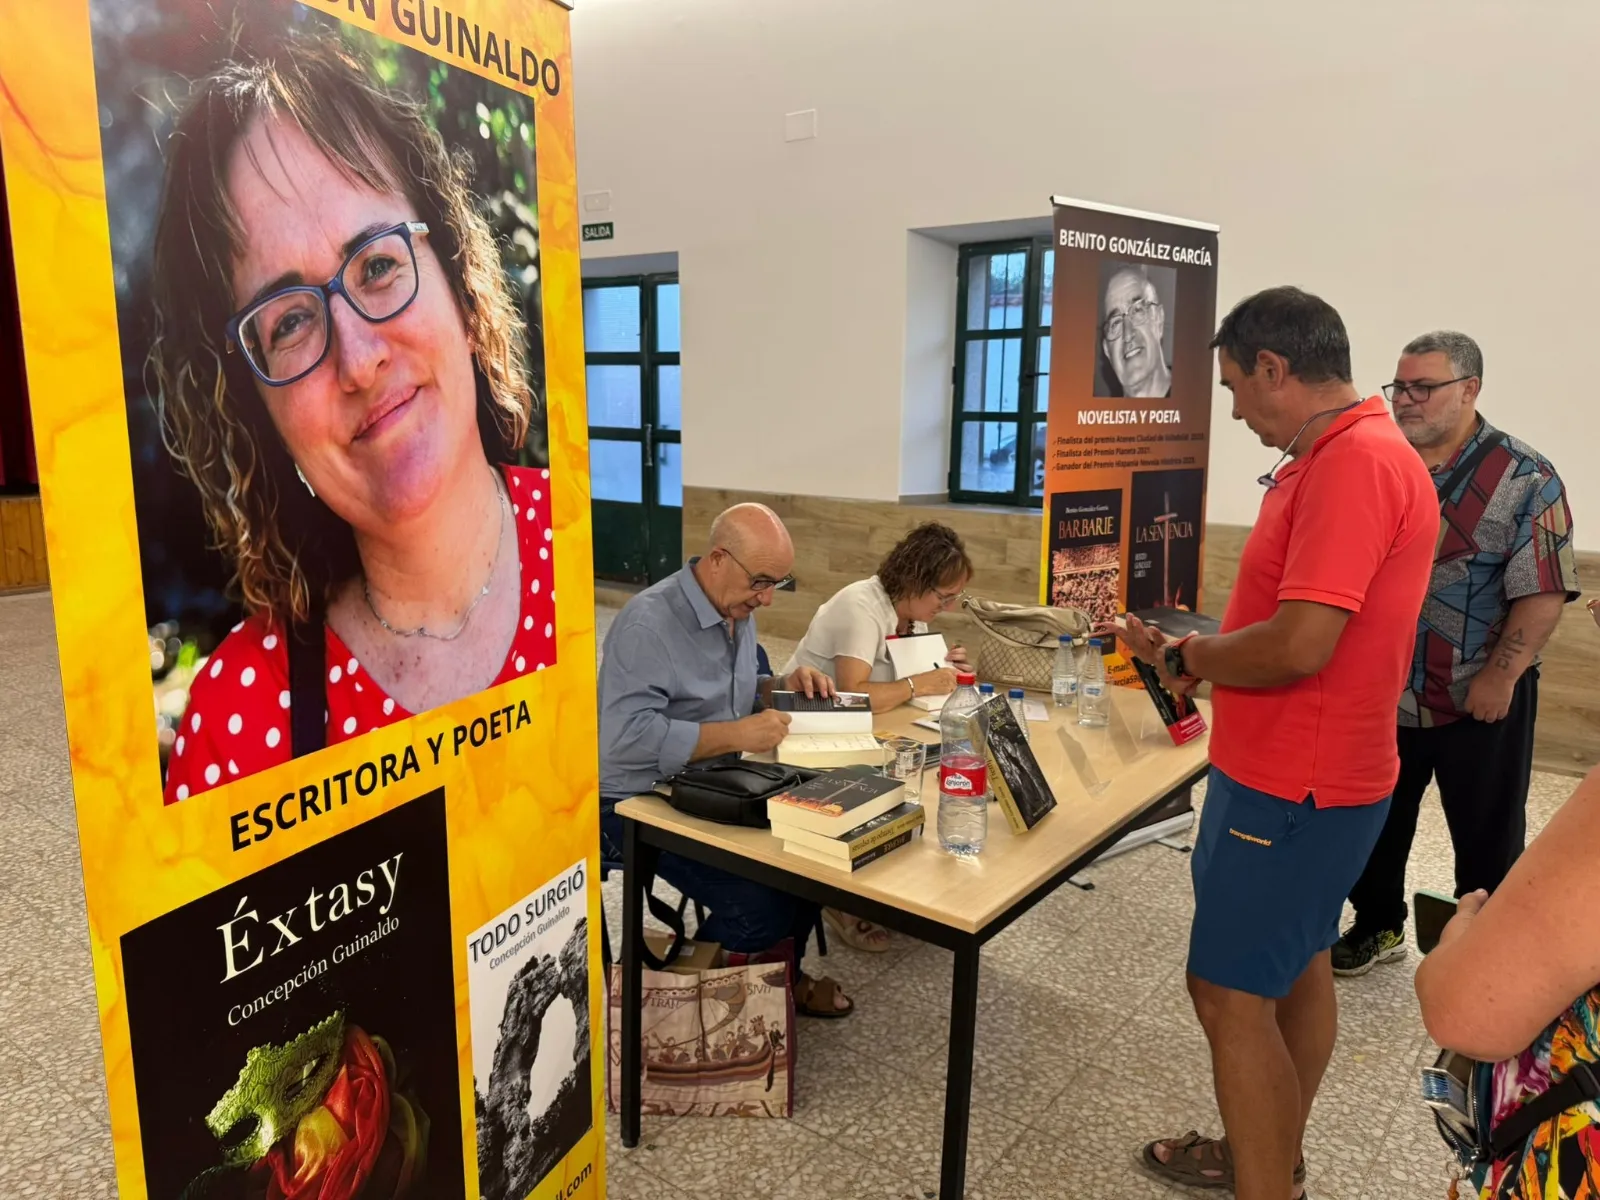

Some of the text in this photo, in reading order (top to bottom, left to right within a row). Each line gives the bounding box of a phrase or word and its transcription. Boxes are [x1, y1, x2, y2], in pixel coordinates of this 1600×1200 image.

[391, 0, 560, 96] GUINALDO
[584, 226, 611, 239] SALIDA
[1059, 229, 1212, 266] BENITO GONZÁLEZ GARCÍA
[1077, 409, 1181, 425] NOVELISTA Y POETA
[1056, 449, 1082, 458] Finalista
[1083, 448, 1093, 457] del
[1057, 436, 1083, 445] Finalista
[1084, 436, 1094, 444] del
[1082, 461, 1093, 469] del
[1058, 516, 1114, 540] BARBARIE
[229, 699, 532, 852] ESCRITORA Y POETA
[215, 852, 404, 985] Éxtasy
[469, 864, 585, 964] TODO SURGIÓ
[489, 905, 570, 970] Concepción Guinaldo
[227, 916, 400, 1027] Concepción Guinaldo
